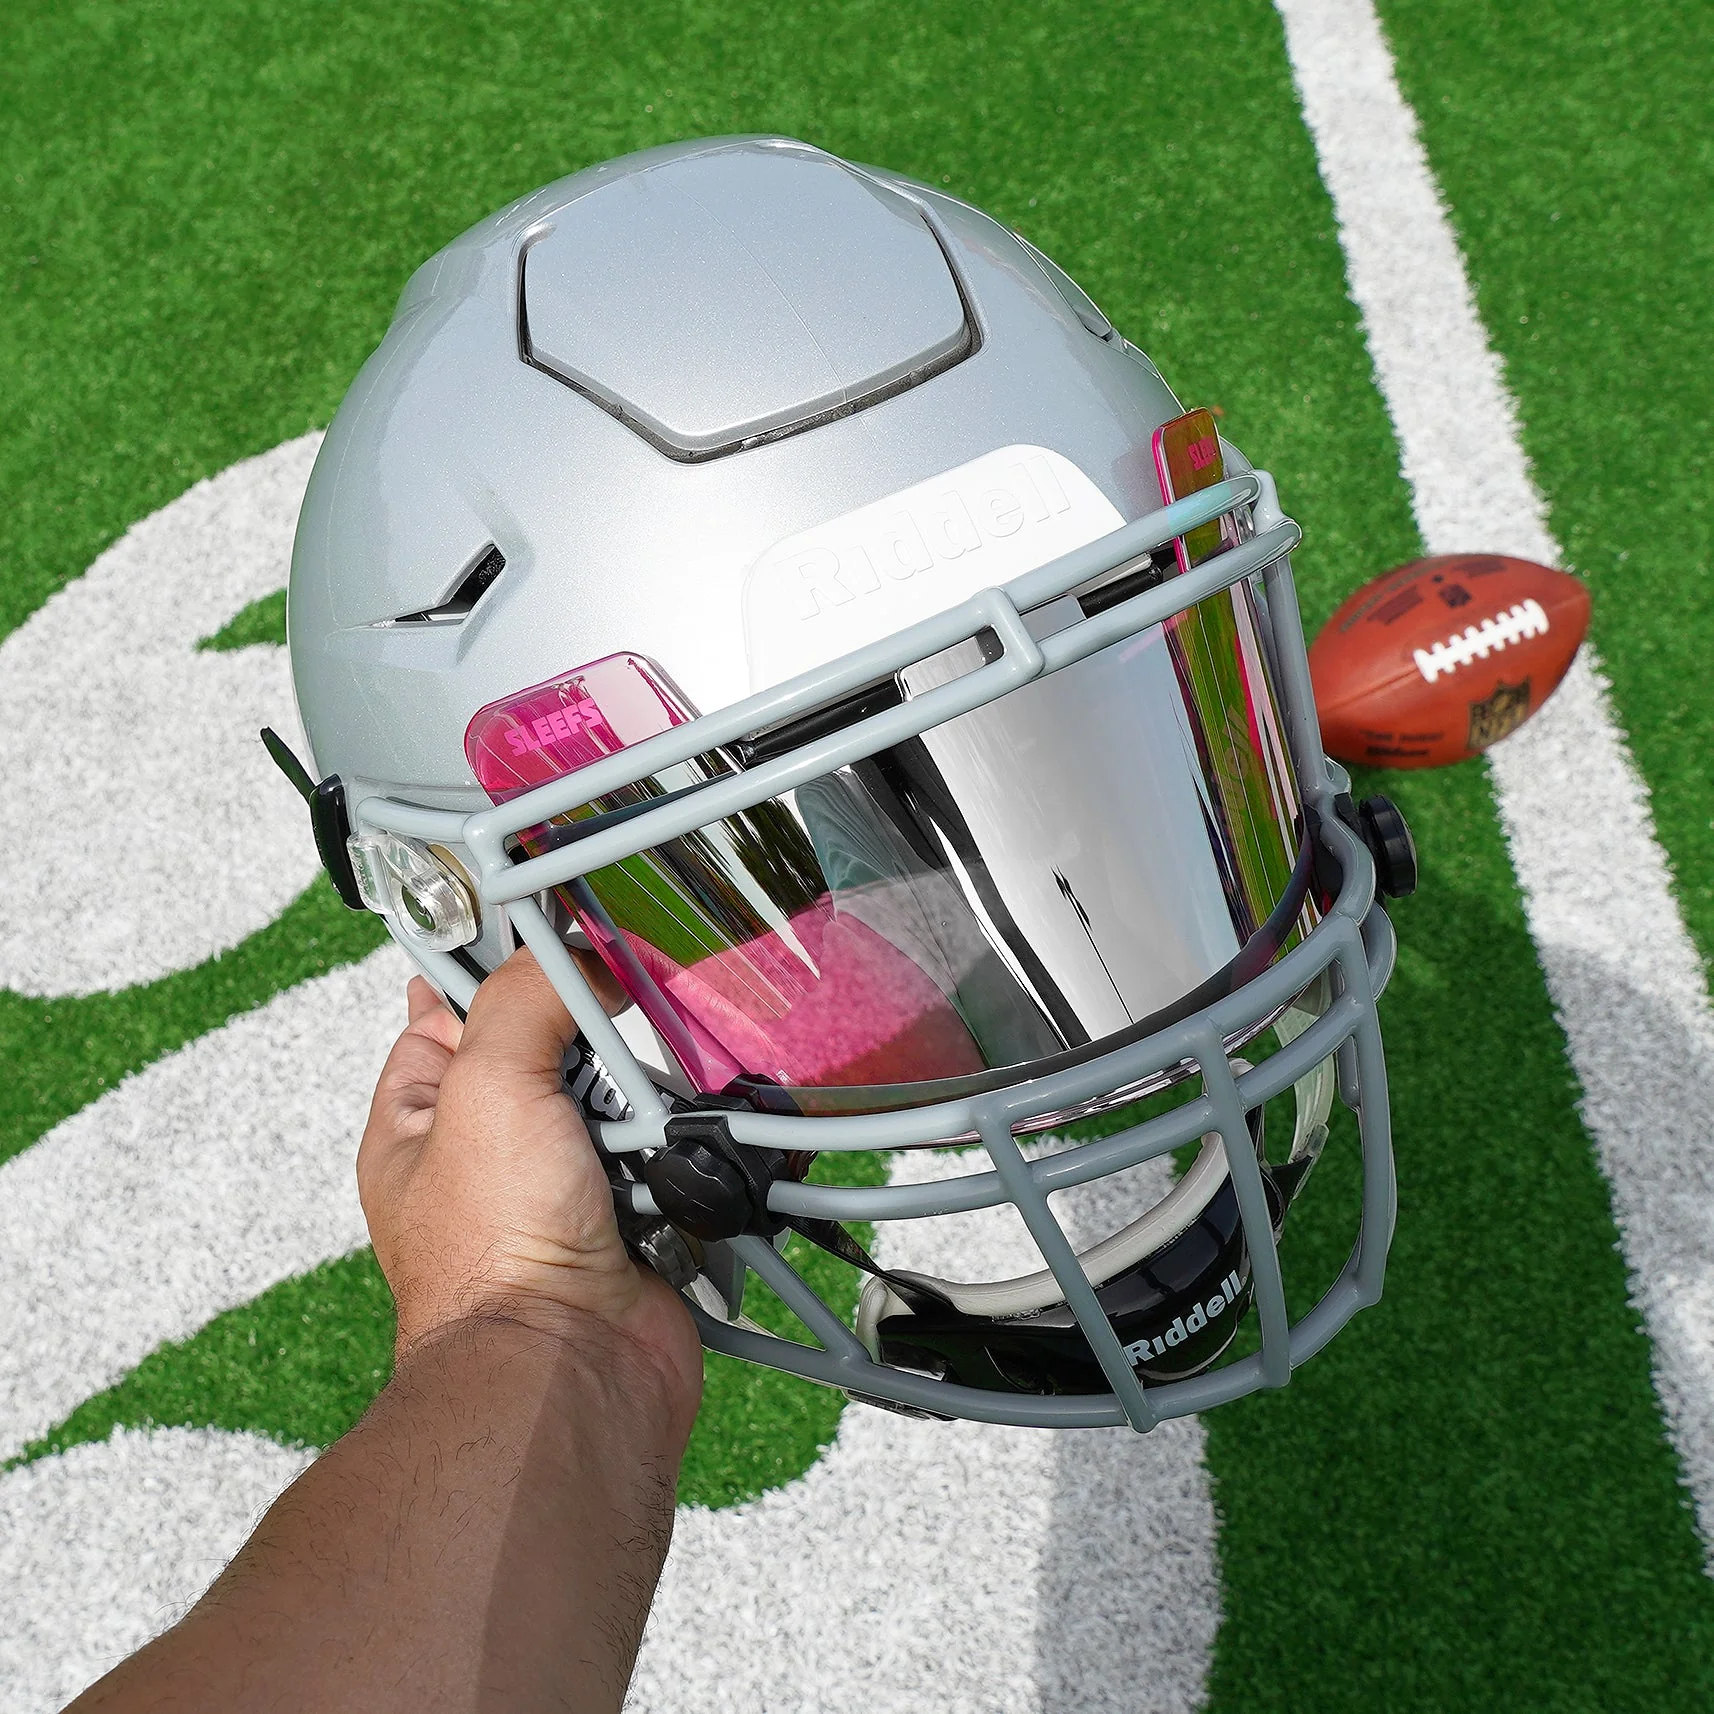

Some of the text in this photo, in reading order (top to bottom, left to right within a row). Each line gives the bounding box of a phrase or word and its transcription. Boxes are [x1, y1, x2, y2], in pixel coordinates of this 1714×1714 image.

[775, 454, 1071, 620] Riddell
[505, 698, 602, 757] SLEEFS
[1123, 1270, 1243, 1366] Riddell
